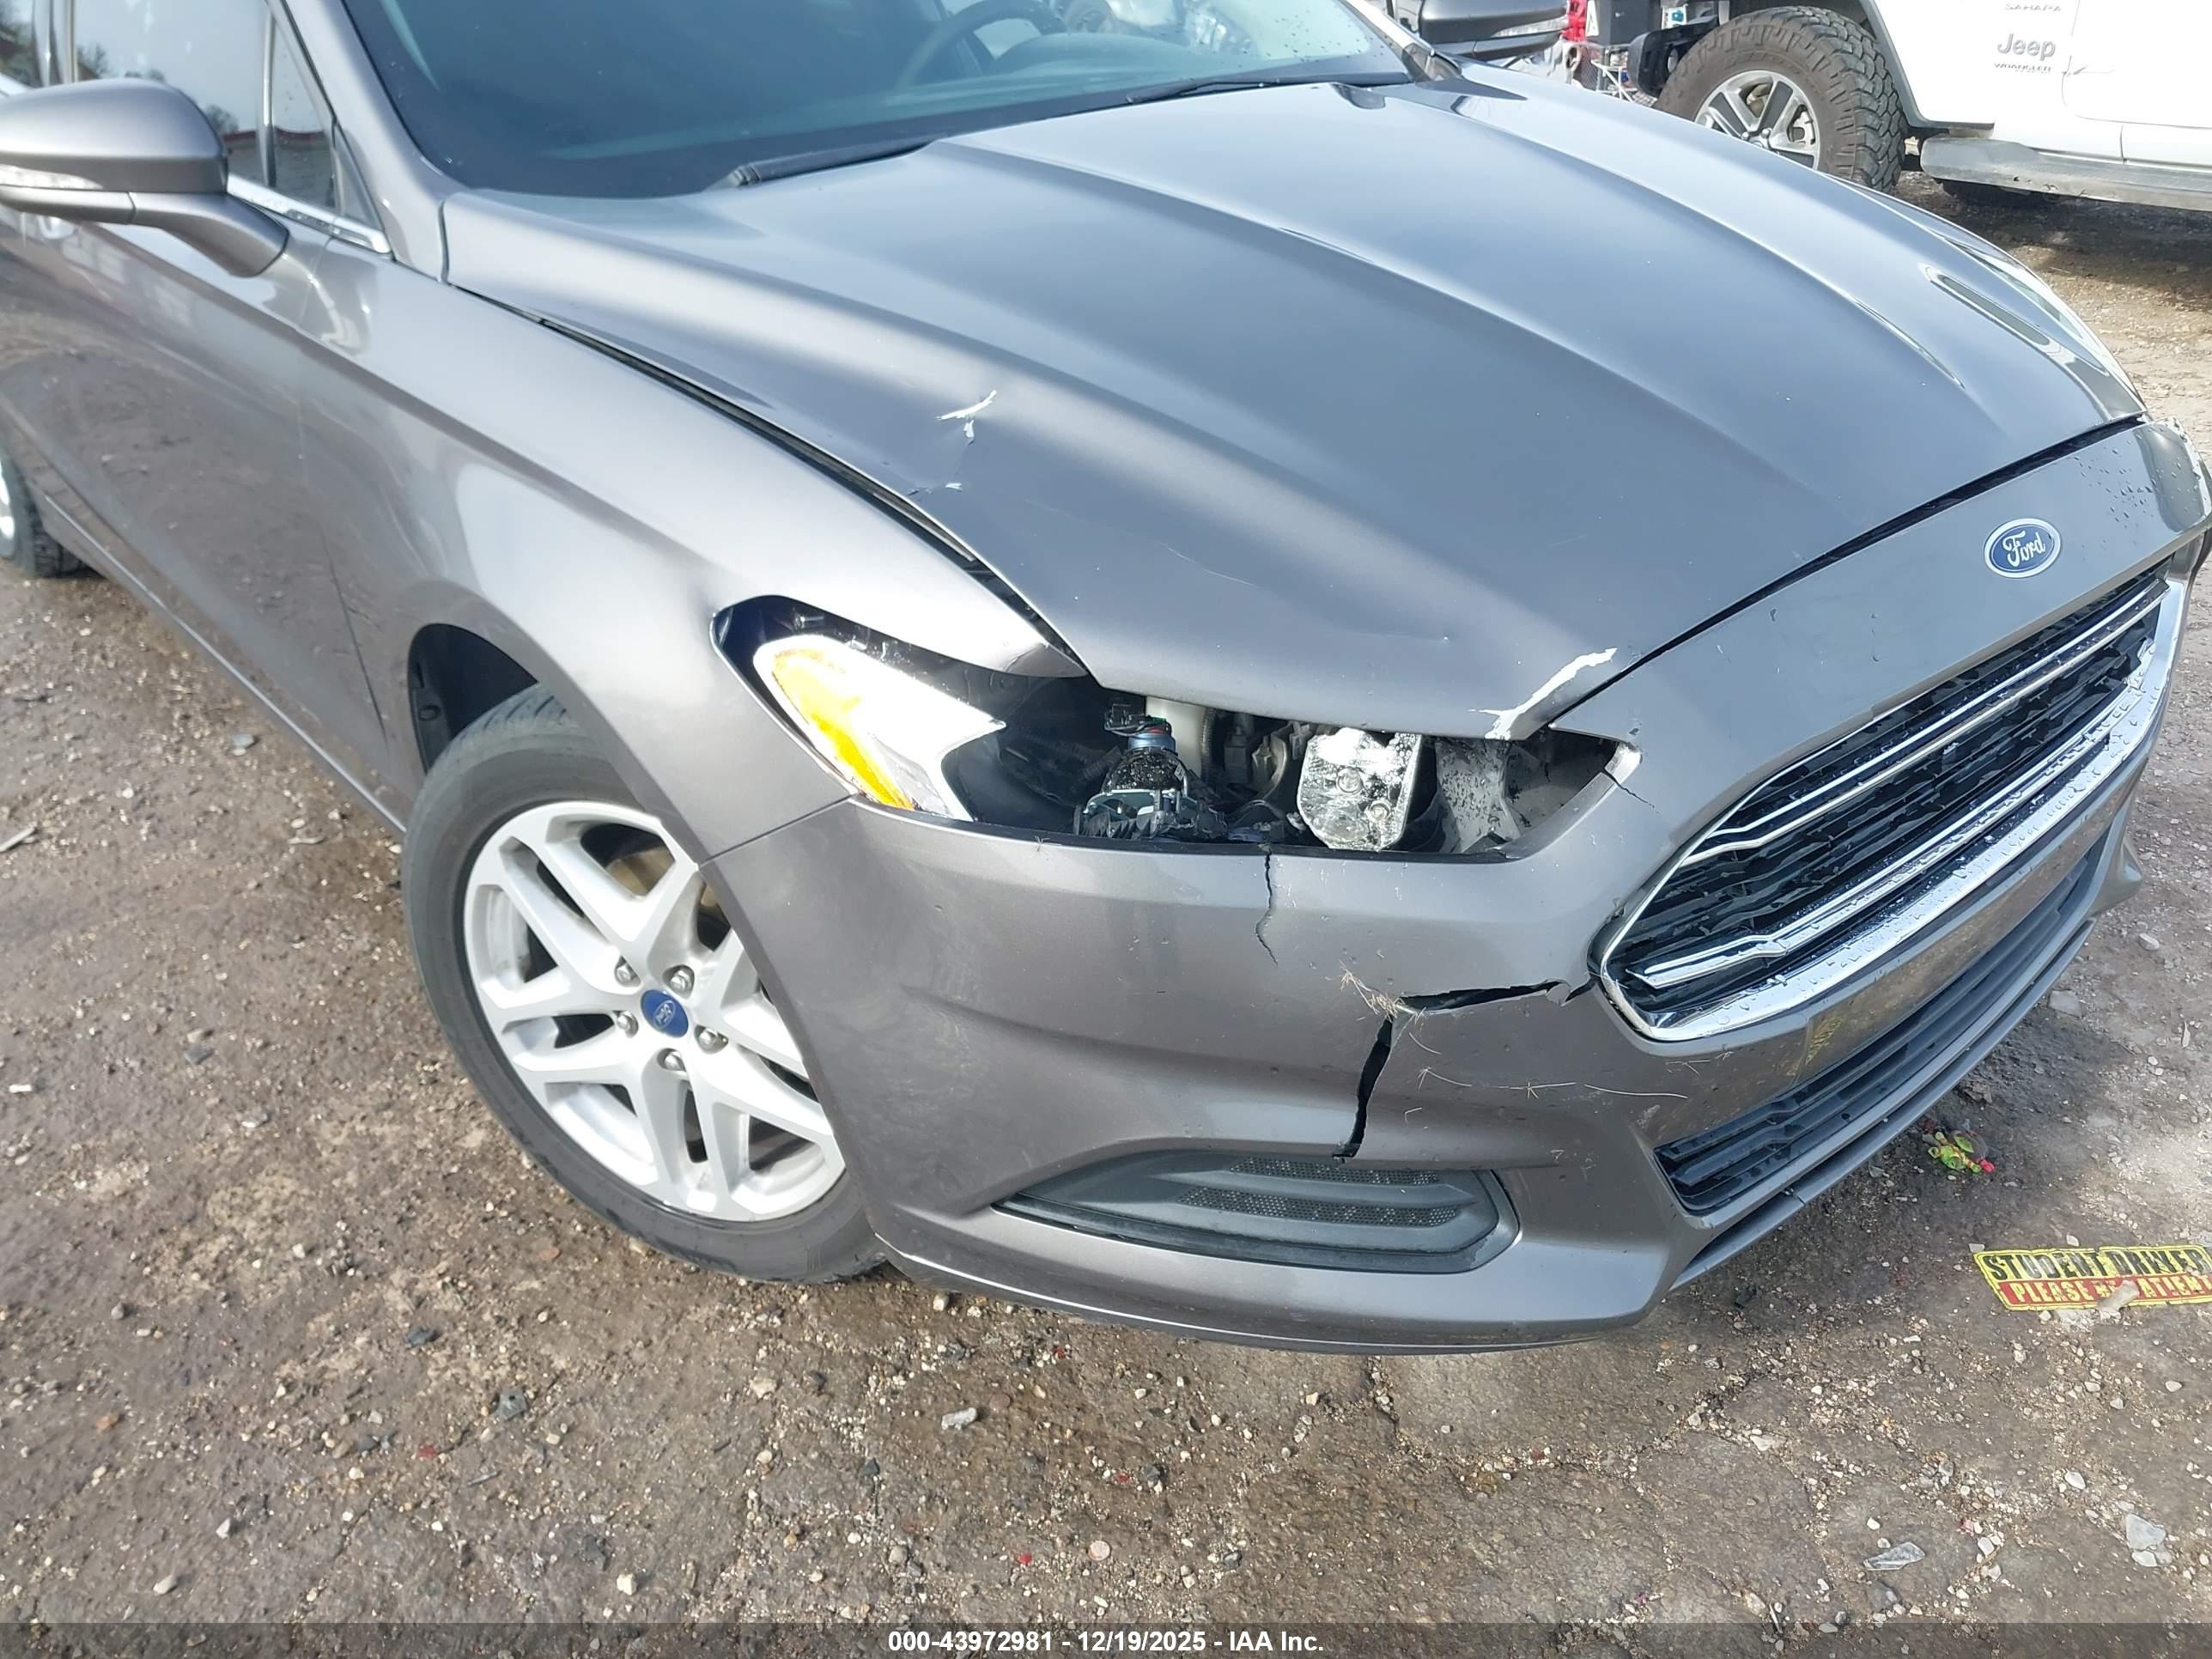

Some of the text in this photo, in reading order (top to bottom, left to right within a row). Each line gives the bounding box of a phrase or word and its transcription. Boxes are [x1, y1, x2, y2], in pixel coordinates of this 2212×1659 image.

[2004, 3, 2061, 12] SAHARA
[1996, 33, 2057, 61] Jeep
[2002, 530, 2046, 568] Ford
[1982, 1249, 2212, 1280] STUDENT DRIVER
[2009, 1280, 2095, 1303] PLEASE
[2136, 1274, 2212, 1297] ATIENT
